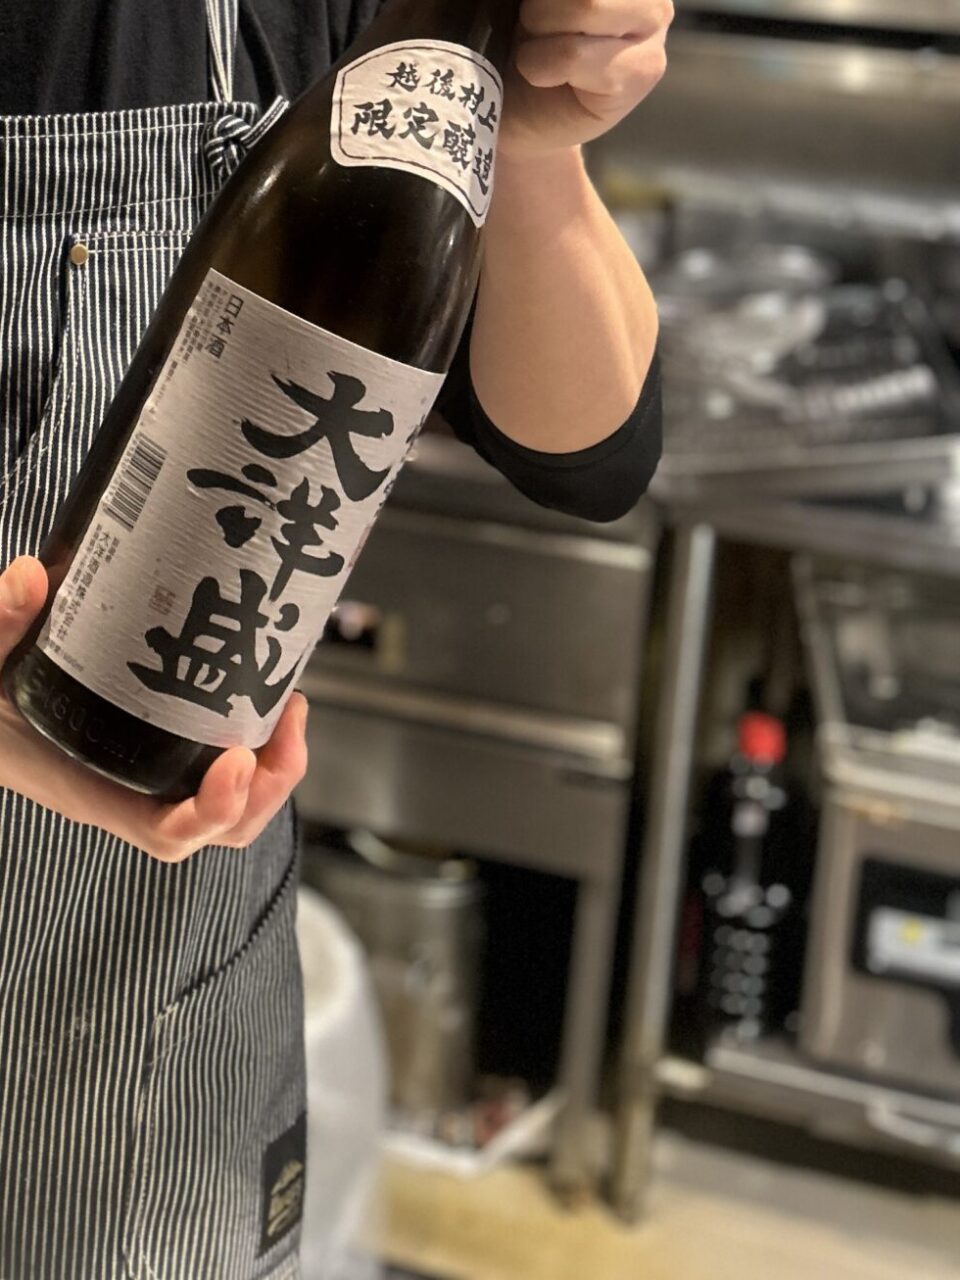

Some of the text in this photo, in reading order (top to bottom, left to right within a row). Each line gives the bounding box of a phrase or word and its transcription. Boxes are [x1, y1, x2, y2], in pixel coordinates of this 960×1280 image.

[387, 62, 497, 132] 越後村上
[205, 293, 244, 359] 日本酒
[126, 370, 395, 717] 大洋盛
